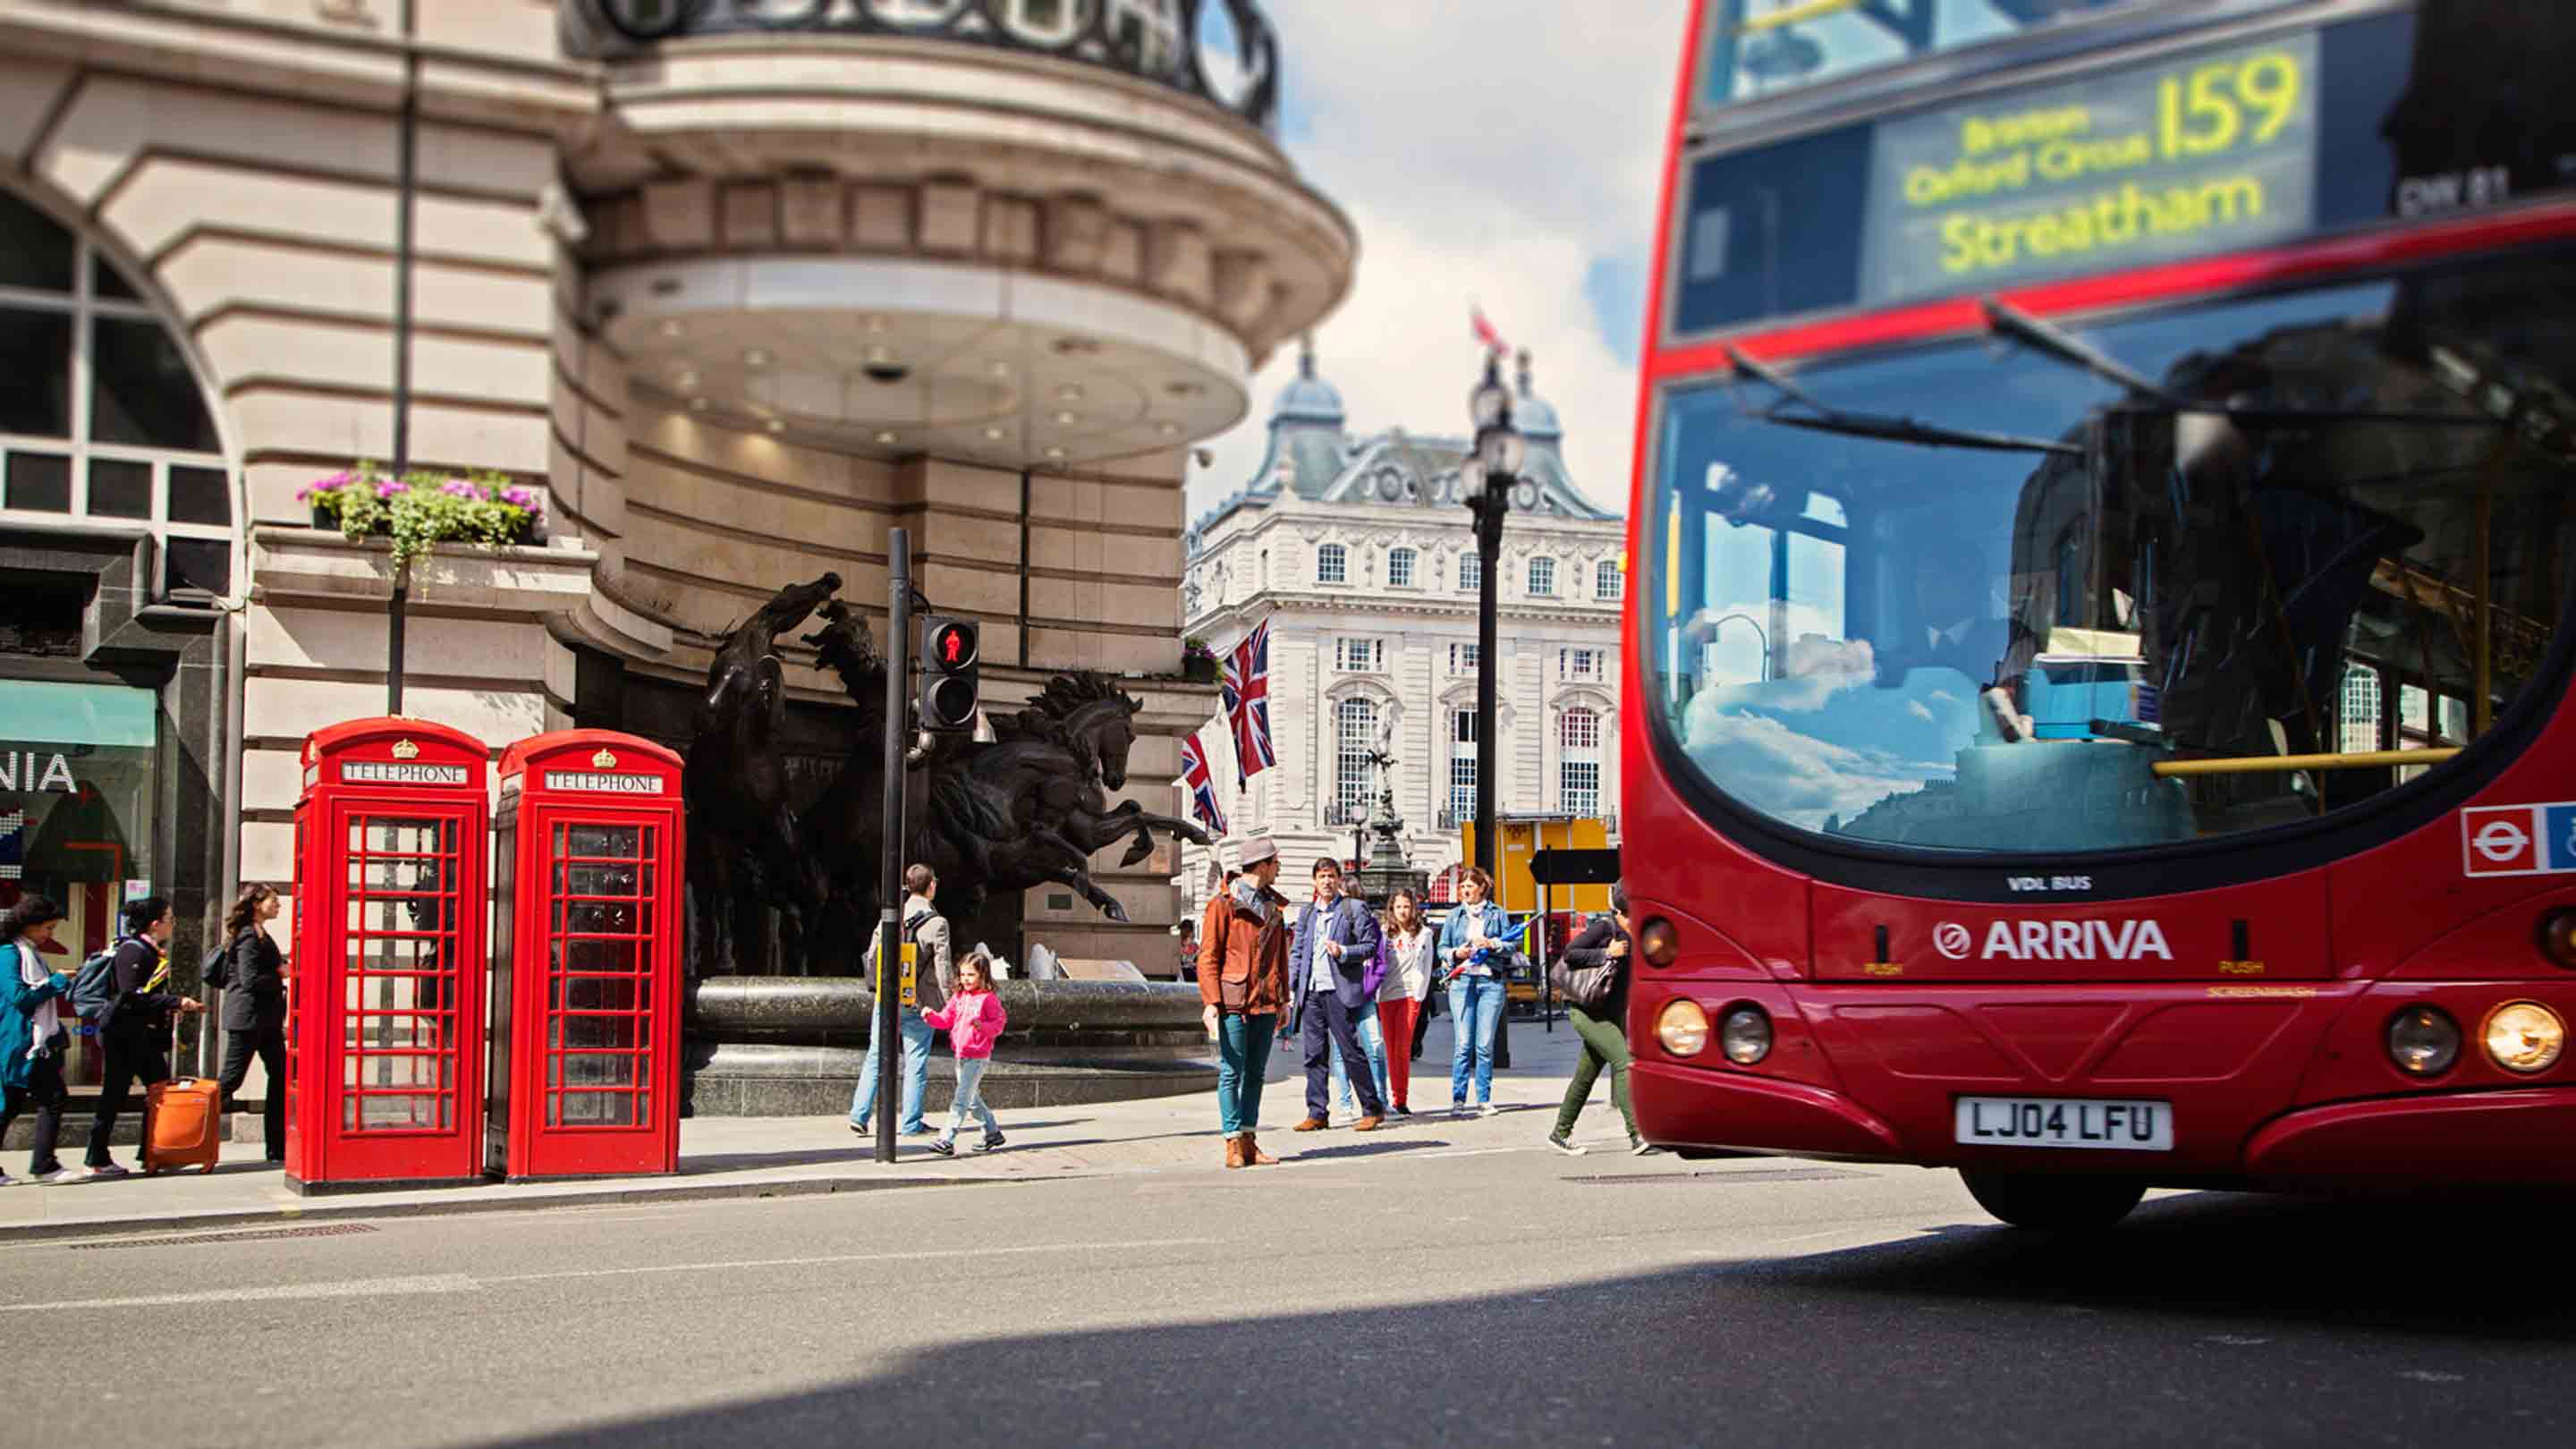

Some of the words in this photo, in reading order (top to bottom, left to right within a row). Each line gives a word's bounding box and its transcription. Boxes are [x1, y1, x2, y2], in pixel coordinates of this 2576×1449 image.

[2157, 49, 2300, 160] 159
[1939, 174, 2264, 273] Streatham
[347, 763, 462, 783] TELEPHONE
[549, 772, 660, 792] TELEPHONE
[2007, 877, 2048, 892] VDL
[2051, 876, 2092, 891] BUS
[1980, 919, 2174, 961] ARRIVA
[1972, 1102, 2067, 1139] LJ04
[2080, 1105, 2154, 1141] LFU
